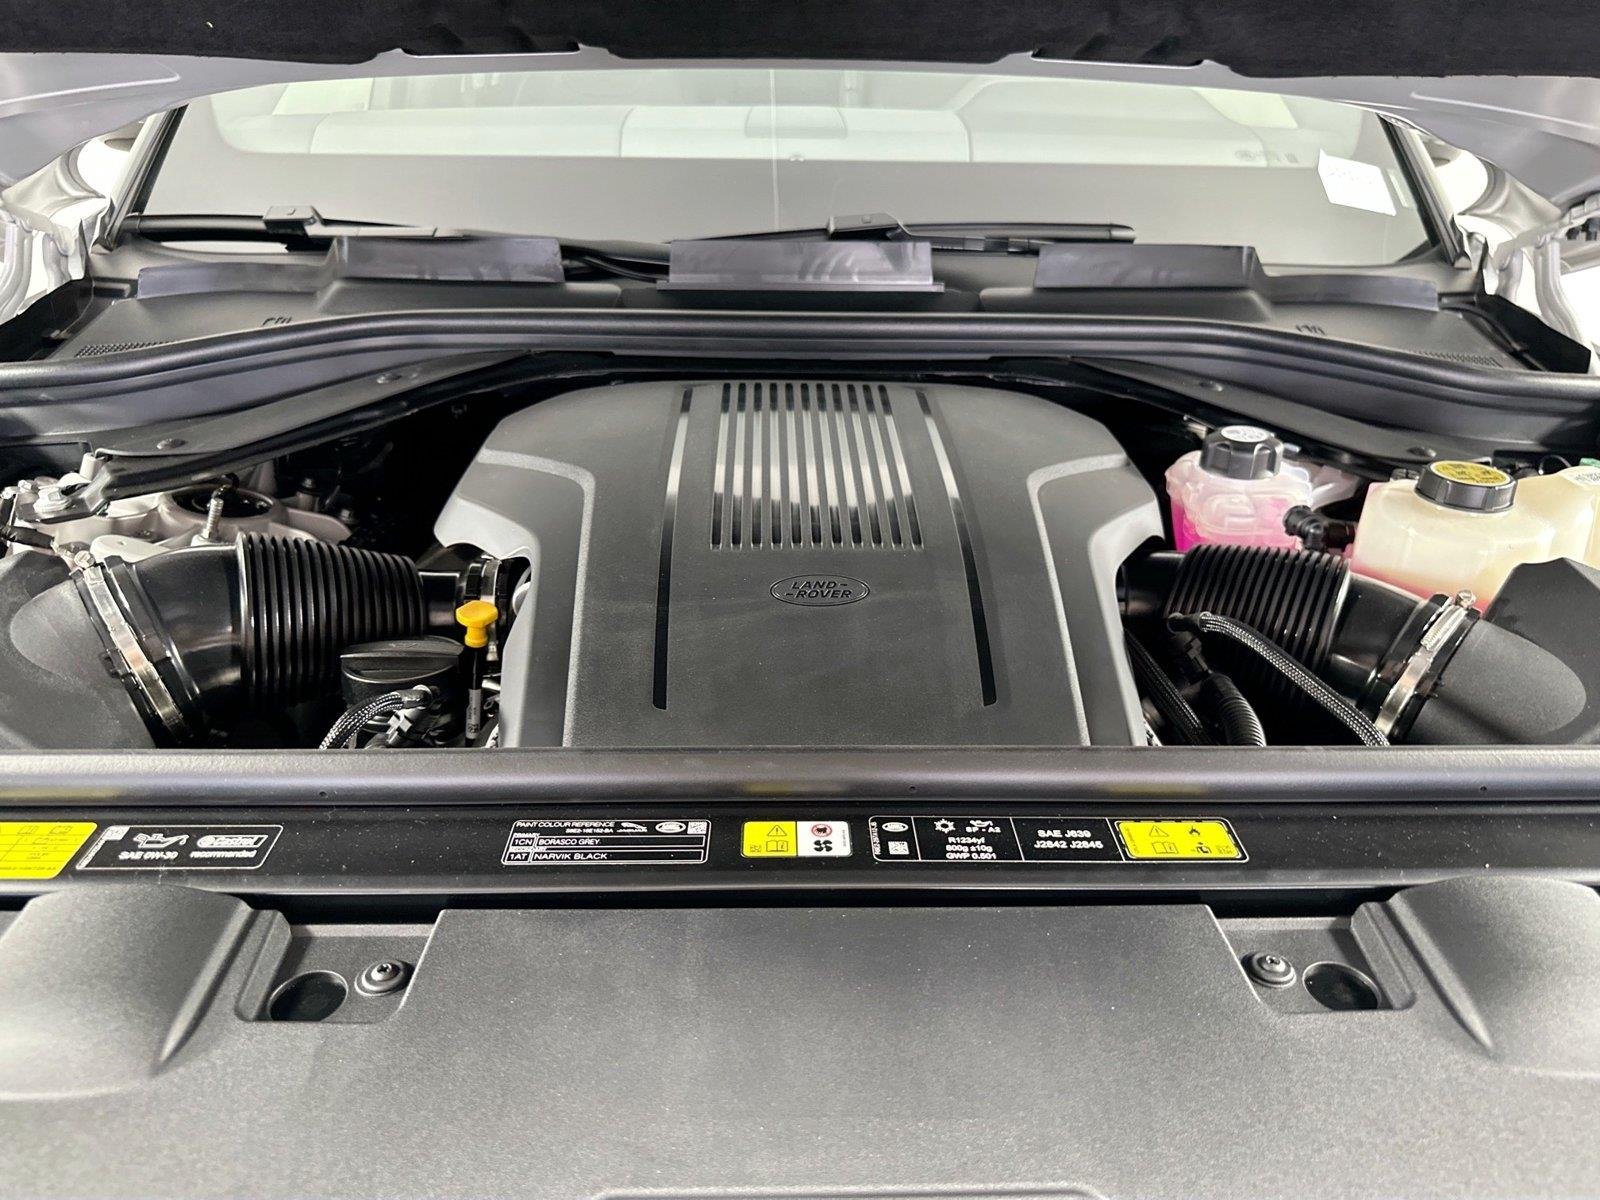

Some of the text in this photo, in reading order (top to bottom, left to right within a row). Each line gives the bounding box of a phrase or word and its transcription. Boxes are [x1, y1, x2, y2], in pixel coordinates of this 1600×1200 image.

[1037, 830, 1062, 838] SAE
[118, 851, 179, 860] SAE 0W-30
[190, 850, 258, 858] recommended
